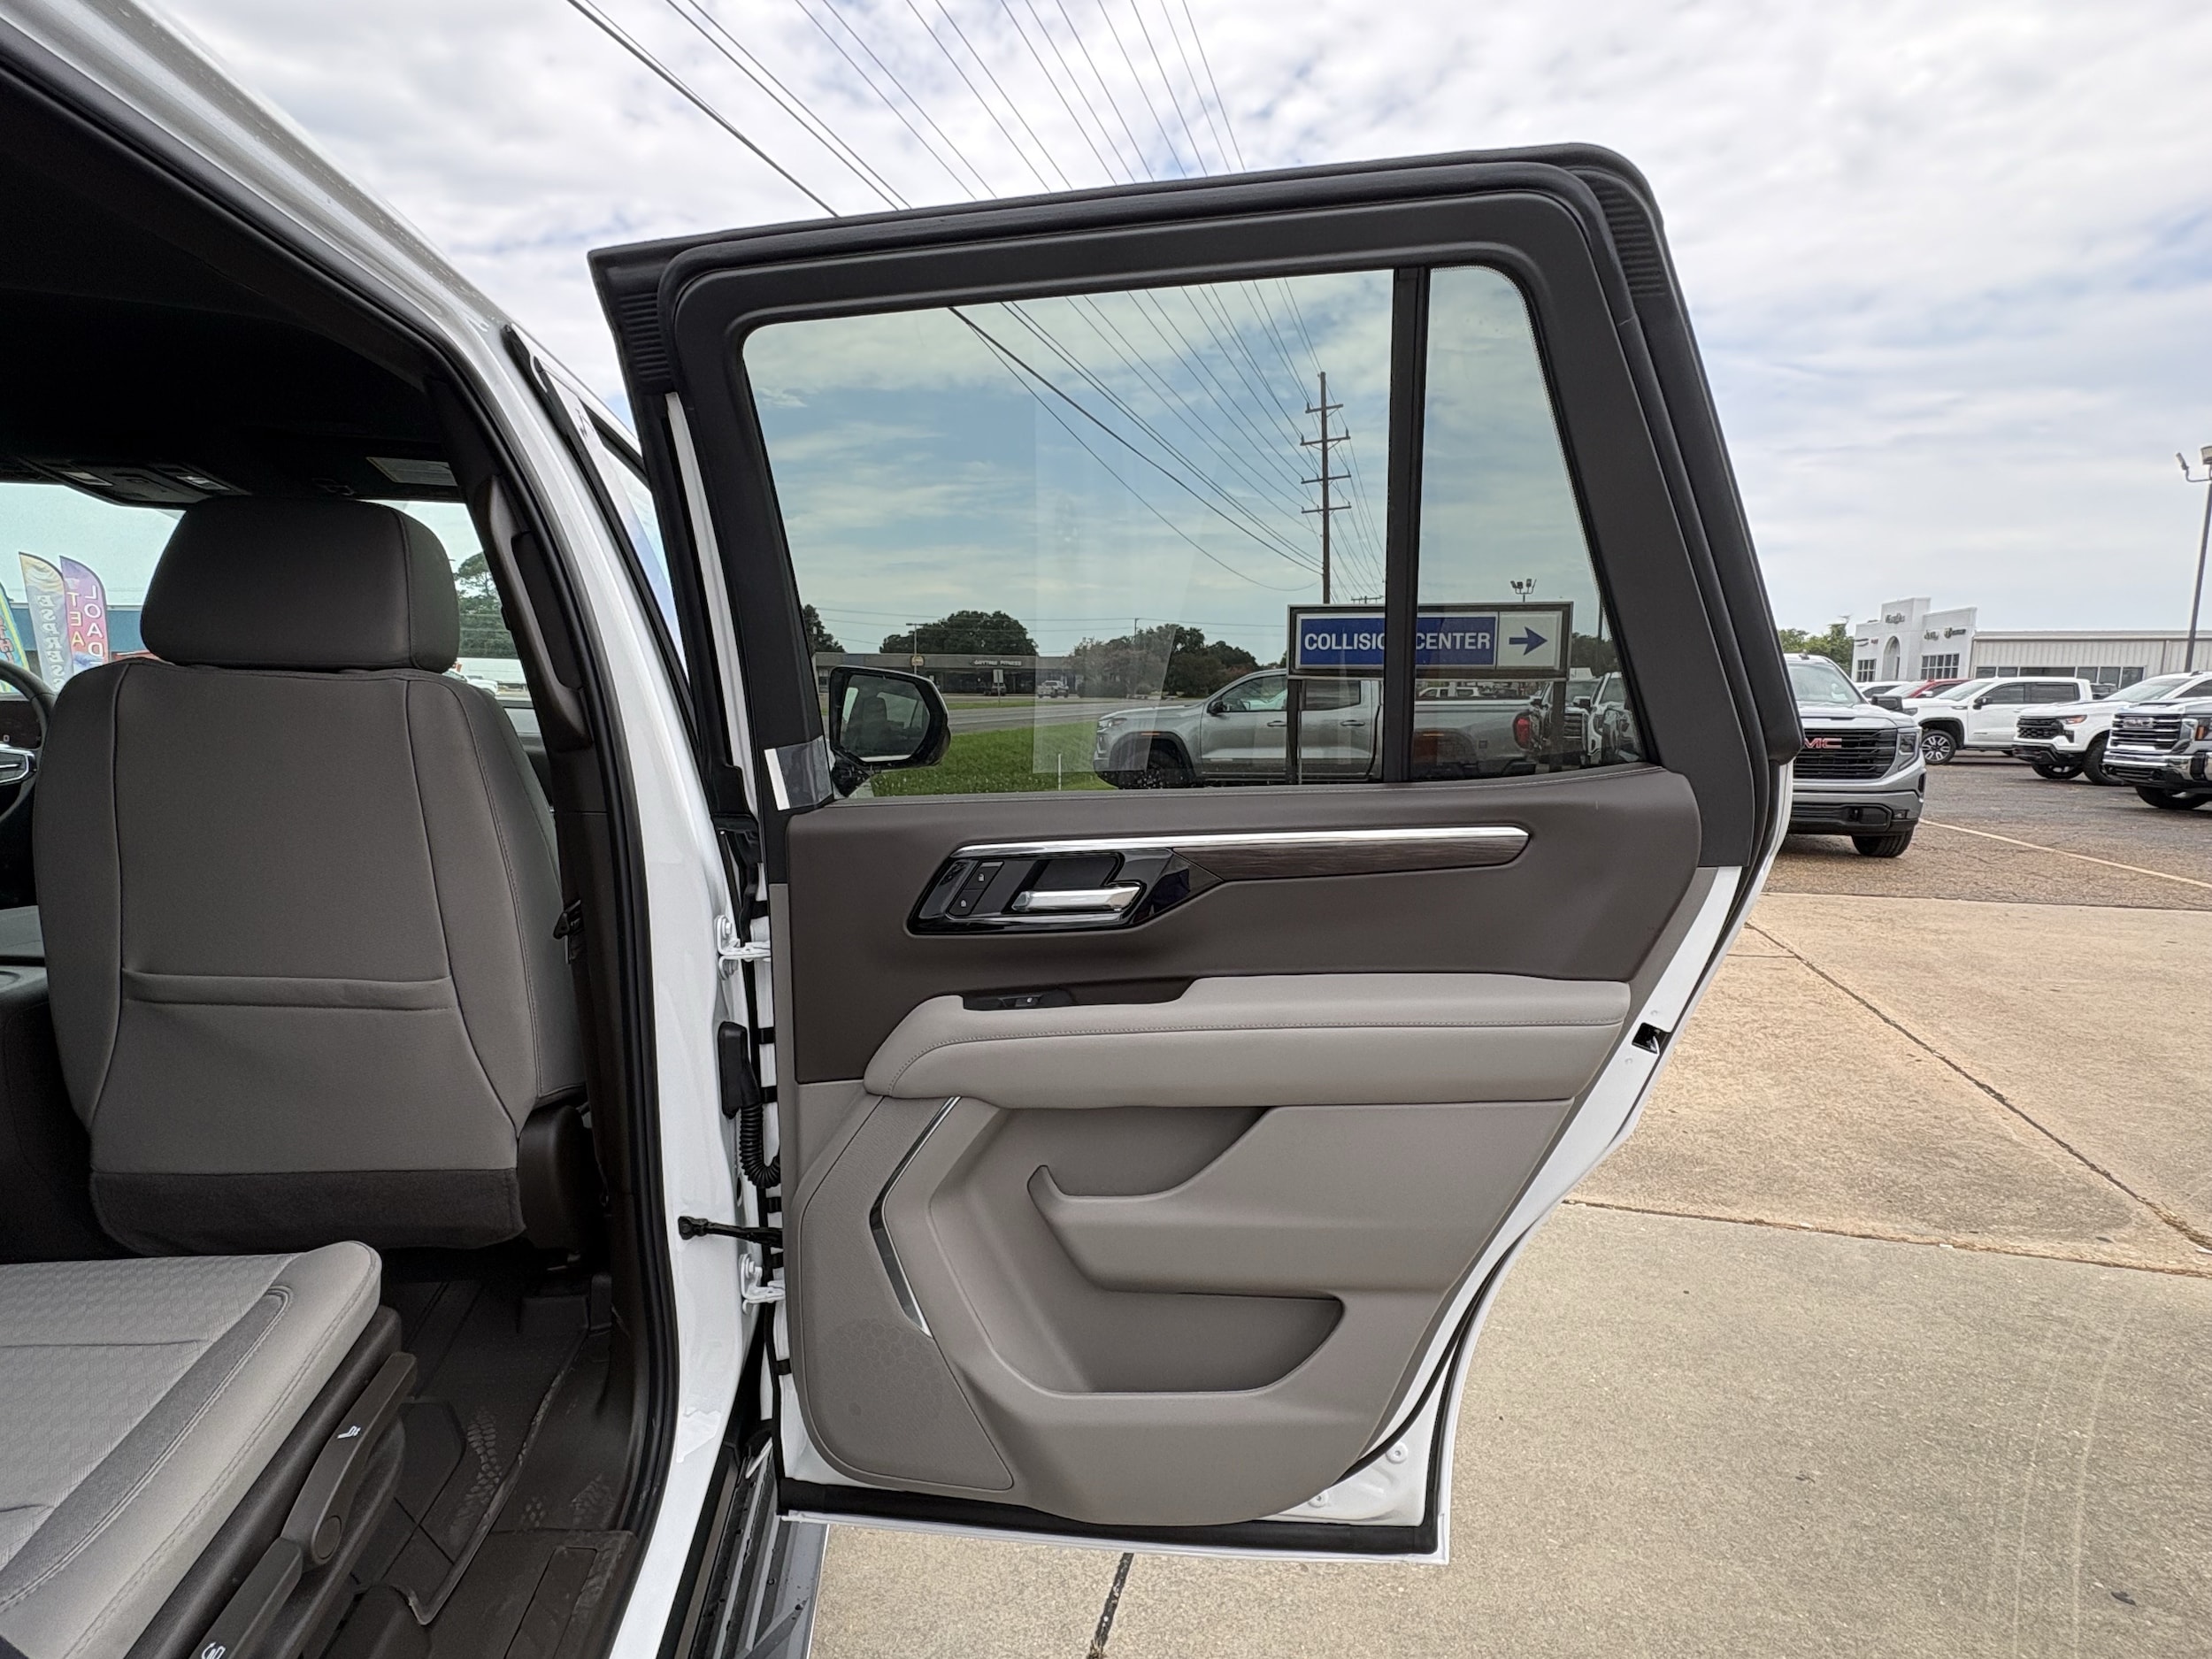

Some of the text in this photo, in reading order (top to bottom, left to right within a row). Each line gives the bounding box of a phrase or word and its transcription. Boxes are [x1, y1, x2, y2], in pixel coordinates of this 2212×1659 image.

[1304, 632, 1490, 651] COLLISIO CENTER
[1804, 737, 1843, 749] MC
